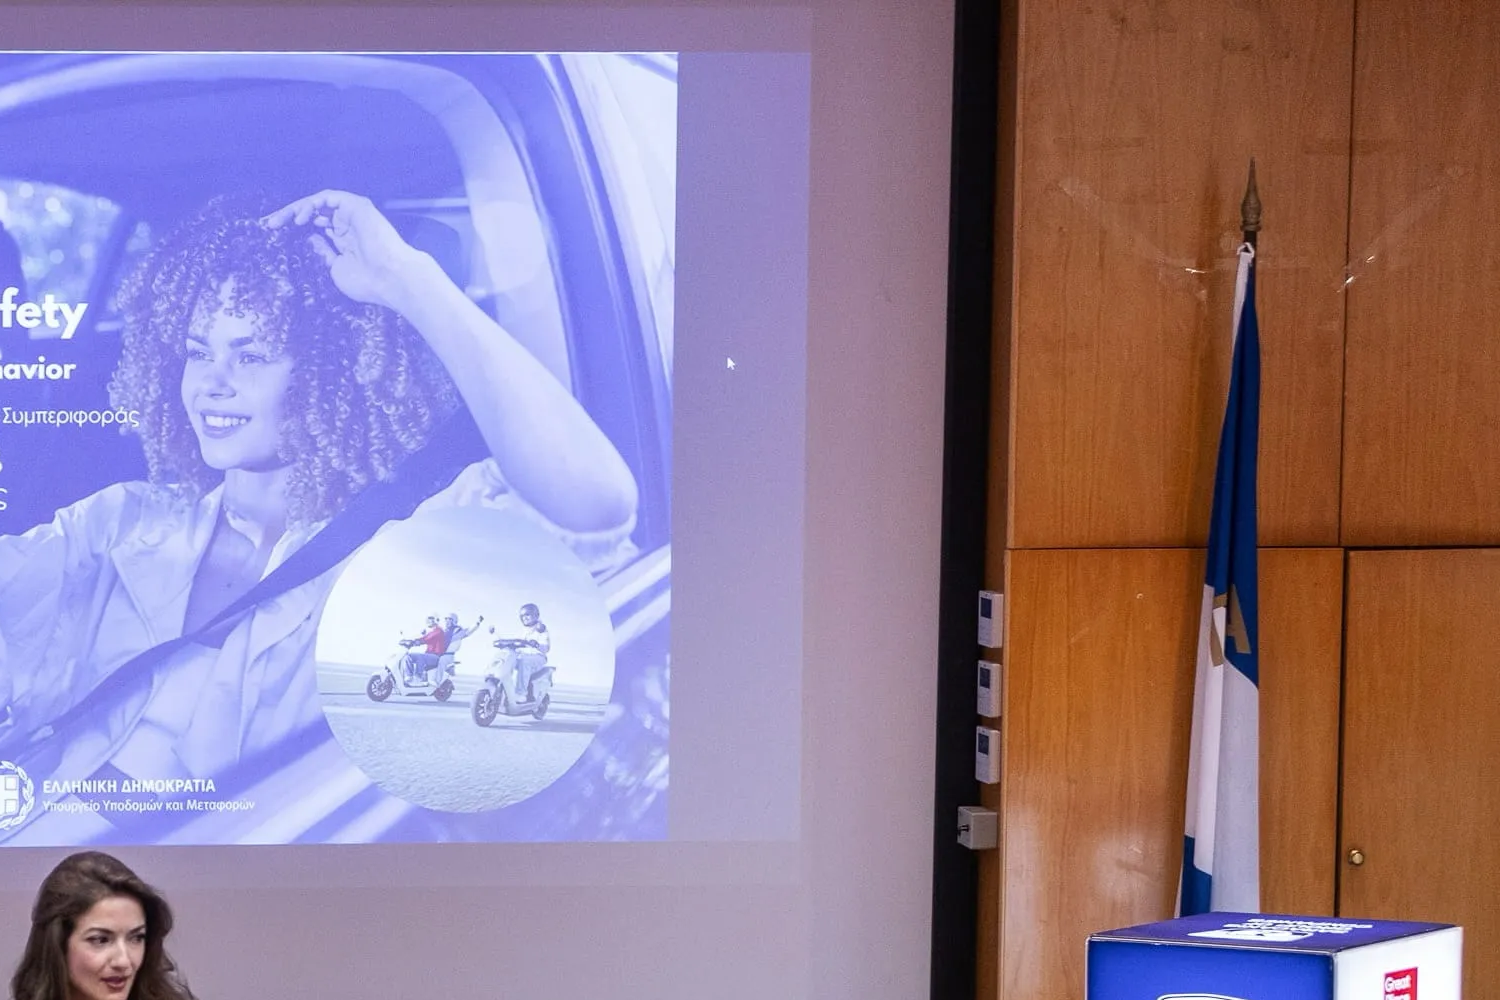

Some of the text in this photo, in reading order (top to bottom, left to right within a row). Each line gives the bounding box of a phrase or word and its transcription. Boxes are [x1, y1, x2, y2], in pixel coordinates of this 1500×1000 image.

[2, 406, 140, 428] Συμπεριφοράς
[43, 779, 216, 793] ΕΛΛΗΝΙΚΗ ΔΗΜΟΚΡΑΤΙΑ
[102, 799, 163, 813] Υποδομών
[166, 802, 184, 811] και
[186, 799, 255, 813] Μεταφορών
